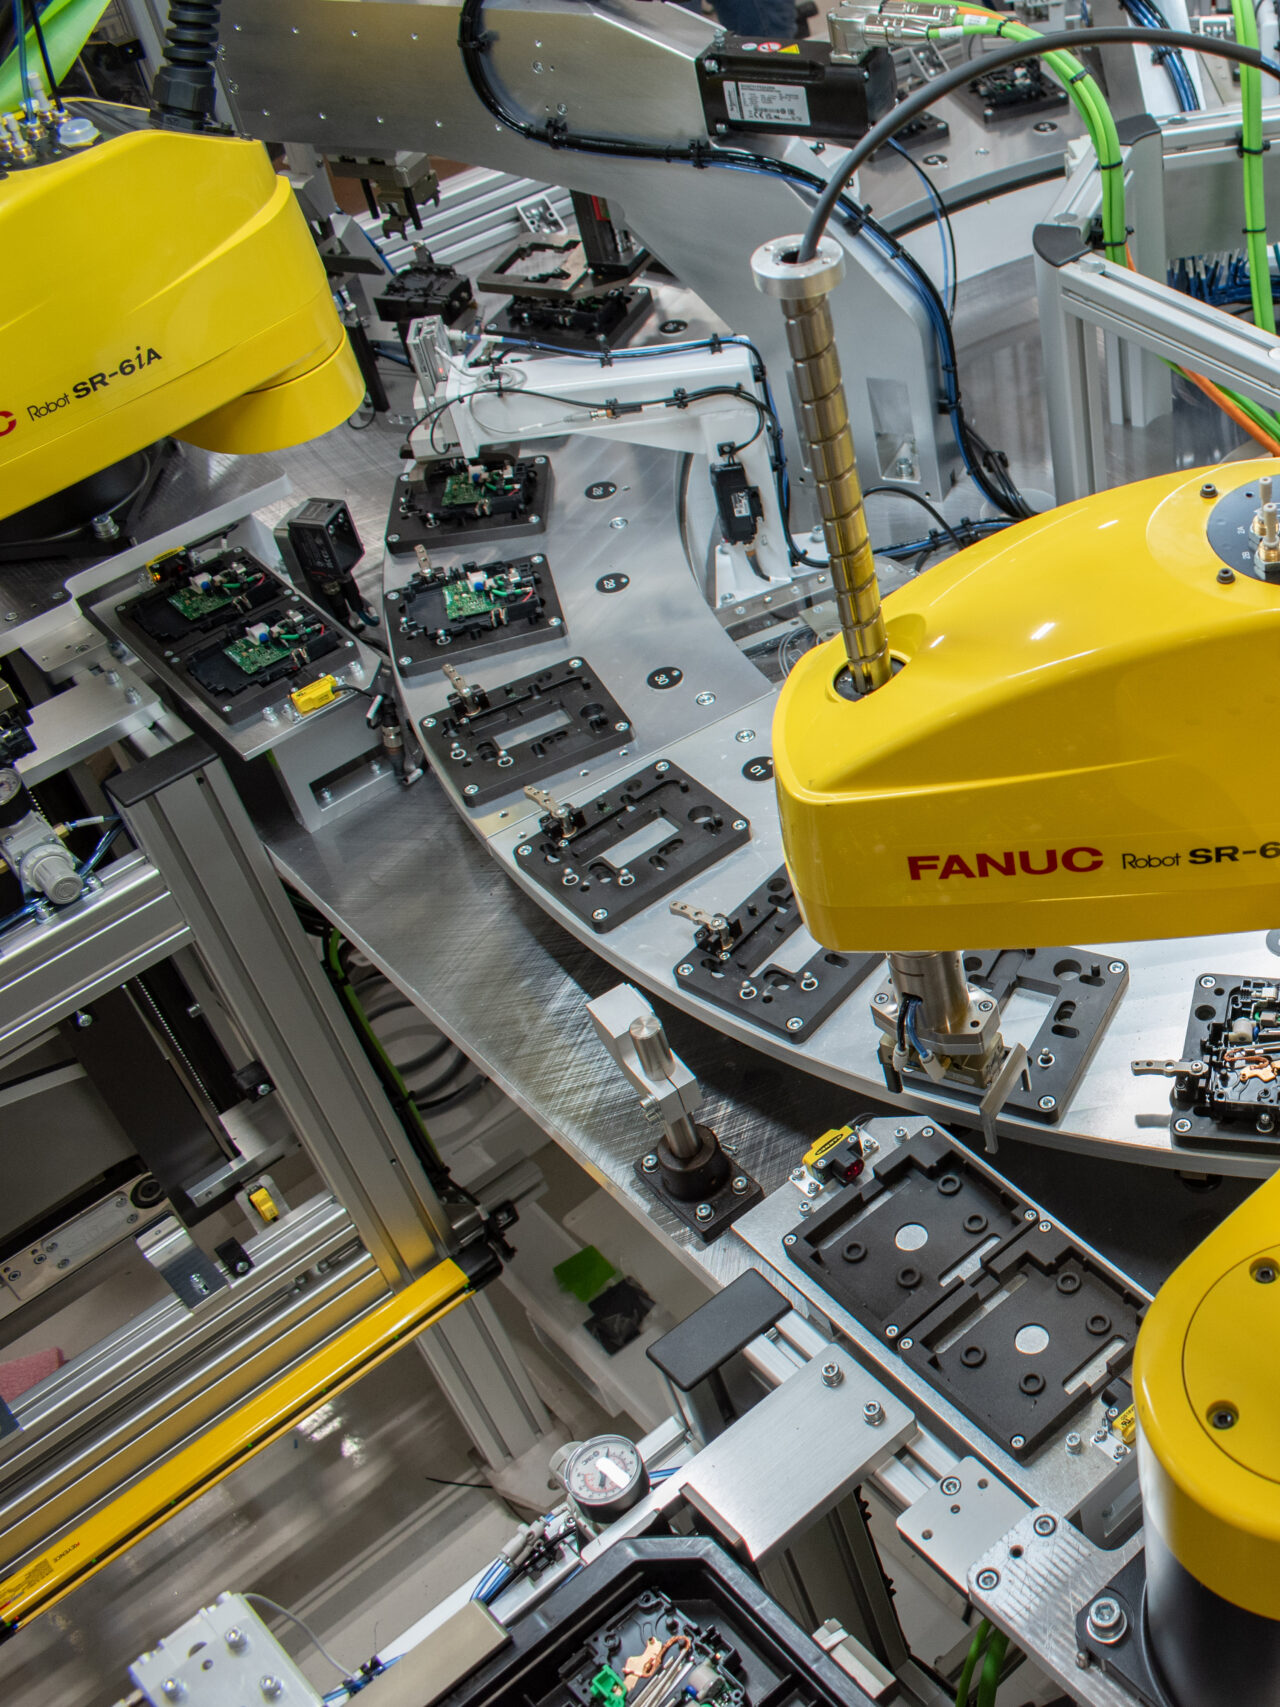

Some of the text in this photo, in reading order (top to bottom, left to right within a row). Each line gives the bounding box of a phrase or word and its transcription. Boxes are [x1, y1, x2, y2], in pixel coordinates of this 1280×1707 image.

[27, 346, 163, 421] Robot SR-6iA
[603, 579, 616, 589] 29
[654, 674, 669, 685] 30
[750, 765, 766, 776] 01
[907, 846, 1104, 881] FANUC
[1122, 852, 1182, 870] Robot
